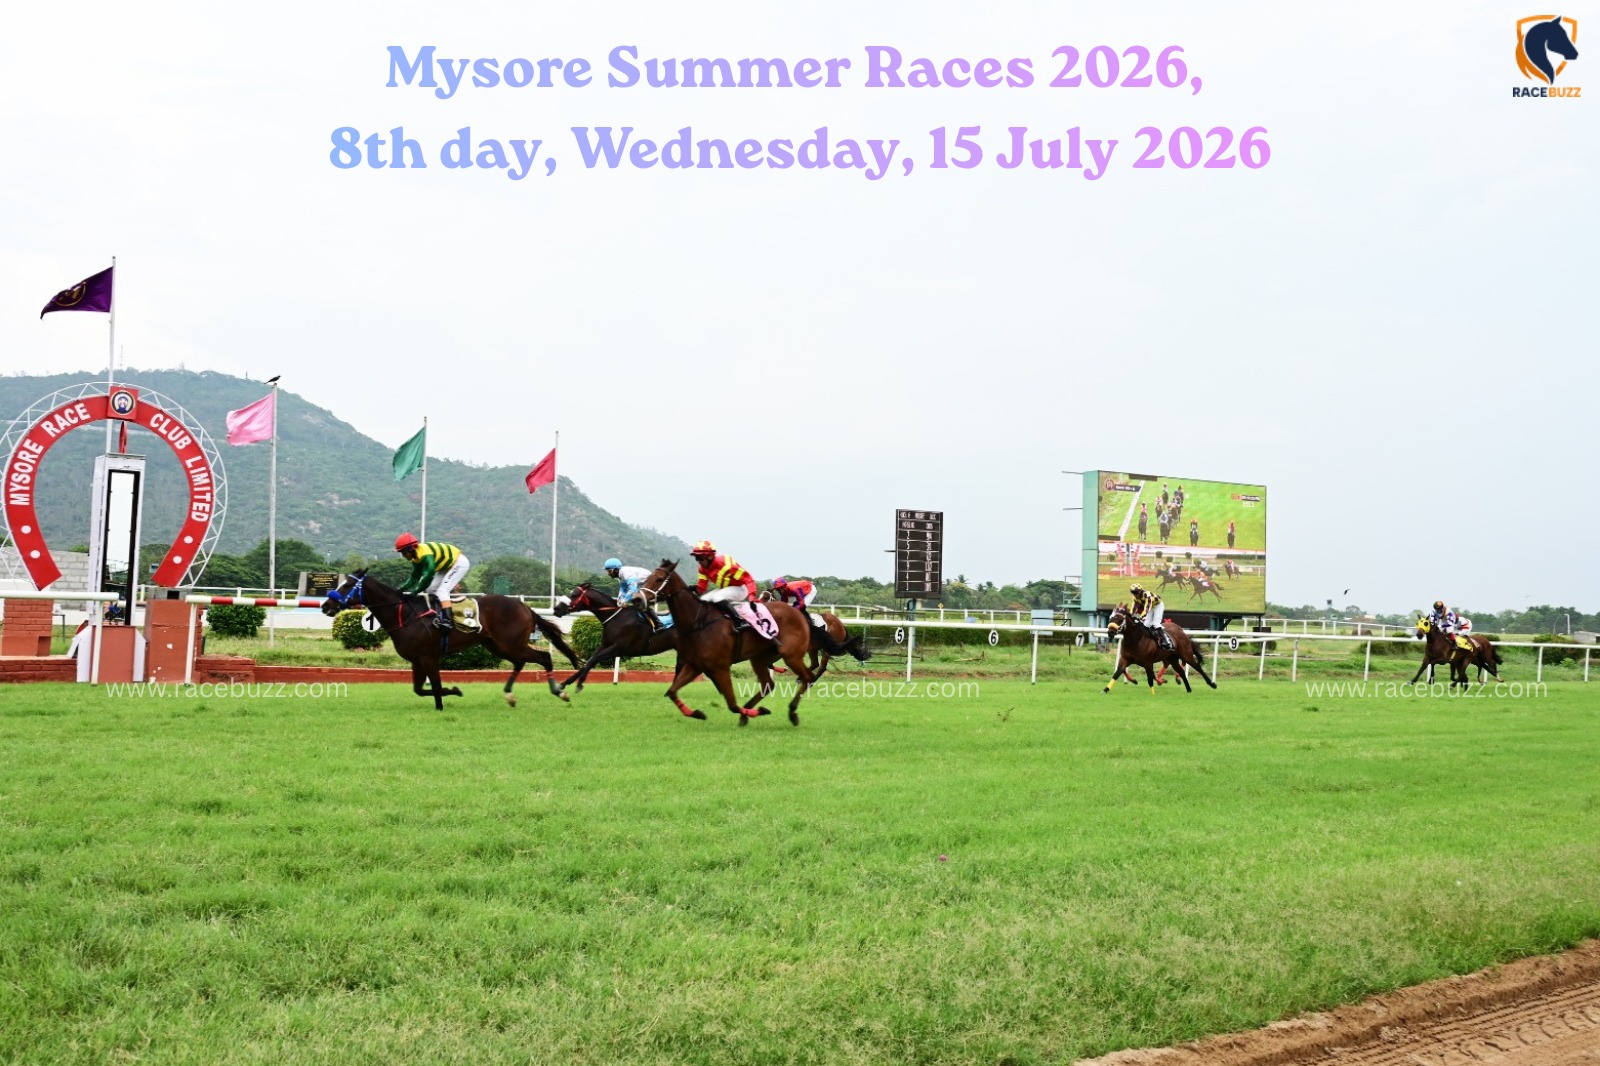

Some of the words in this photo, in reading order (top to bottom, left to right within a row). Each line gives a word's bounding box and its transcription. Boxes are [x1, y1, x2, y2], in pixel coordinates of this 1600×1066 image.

[9, 438, 44, 506] MYSORE
[40, 402, 91, 438] RACE
[150, 413, 192, 451] CLUB
[185, 455, 211, 522] LIMITED
[365, 614, 374, 631] 1
